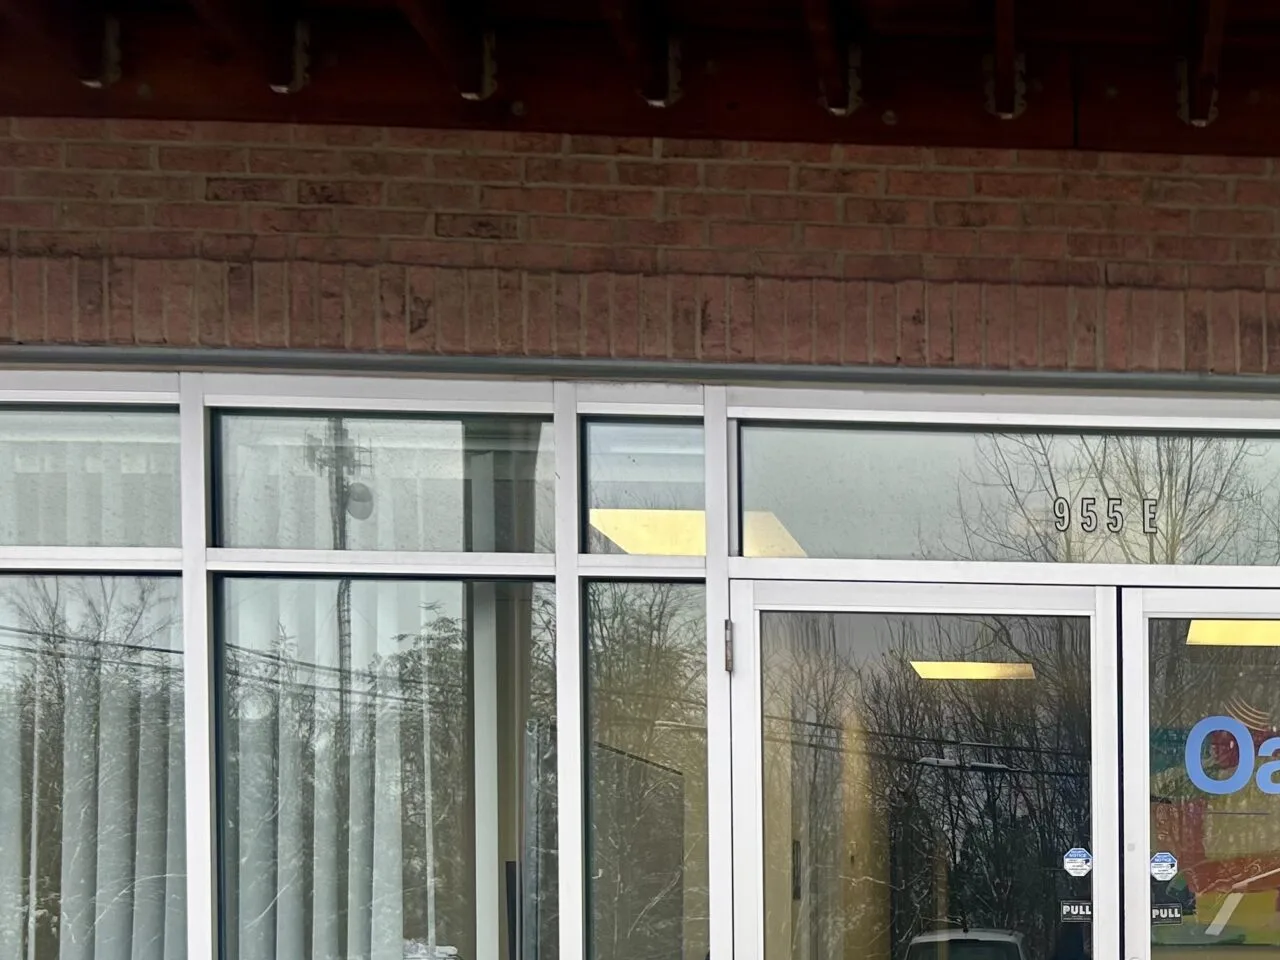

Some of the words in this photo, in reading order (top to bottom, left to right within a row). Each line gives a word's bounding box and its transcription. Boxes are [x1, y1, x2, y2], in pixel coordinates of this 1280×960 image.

[1053, 496, 1124, 533] 955
[1142, 498, 1158, 534] E
[1062, 905, 1092, 915] PULL
[1152, 908, 1181, 918] PULL
